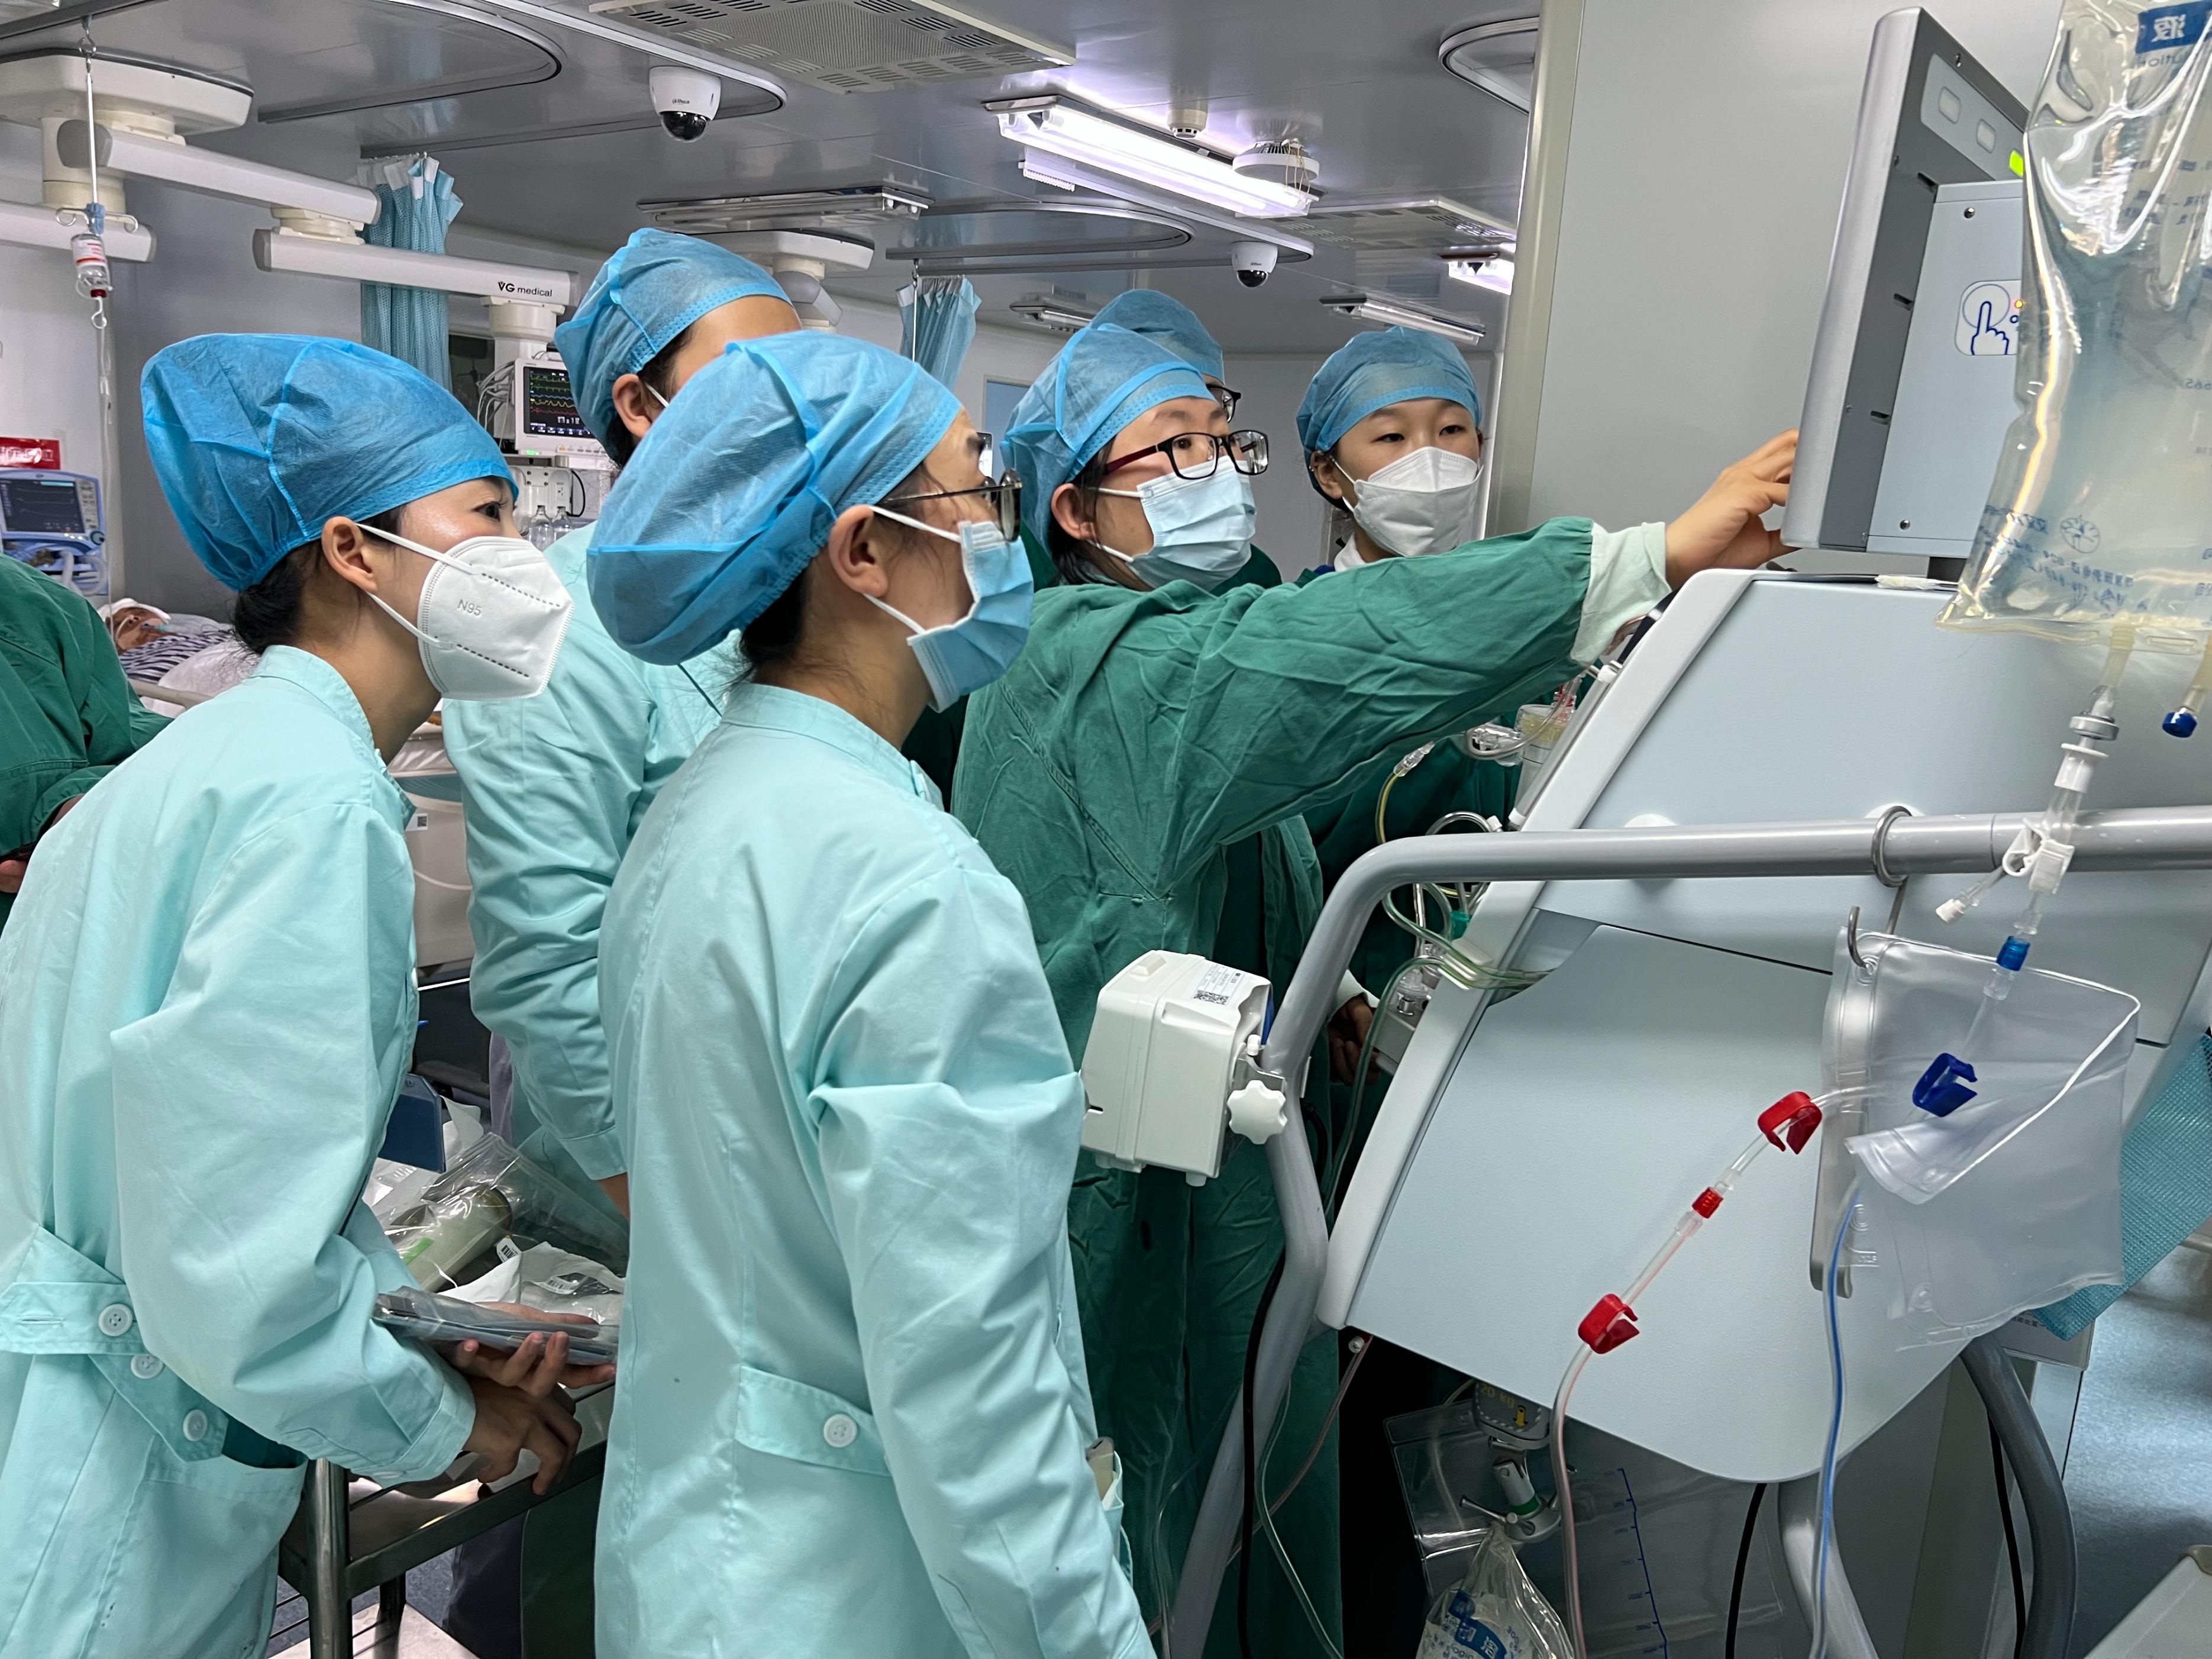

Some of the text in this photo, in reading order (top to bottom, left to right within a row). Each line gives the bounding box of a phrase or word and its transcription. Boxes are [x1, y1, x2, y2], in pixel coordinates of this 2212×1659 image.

[498, 281, 553, 296] VG medical
[457, 599, 482, 617] N95
